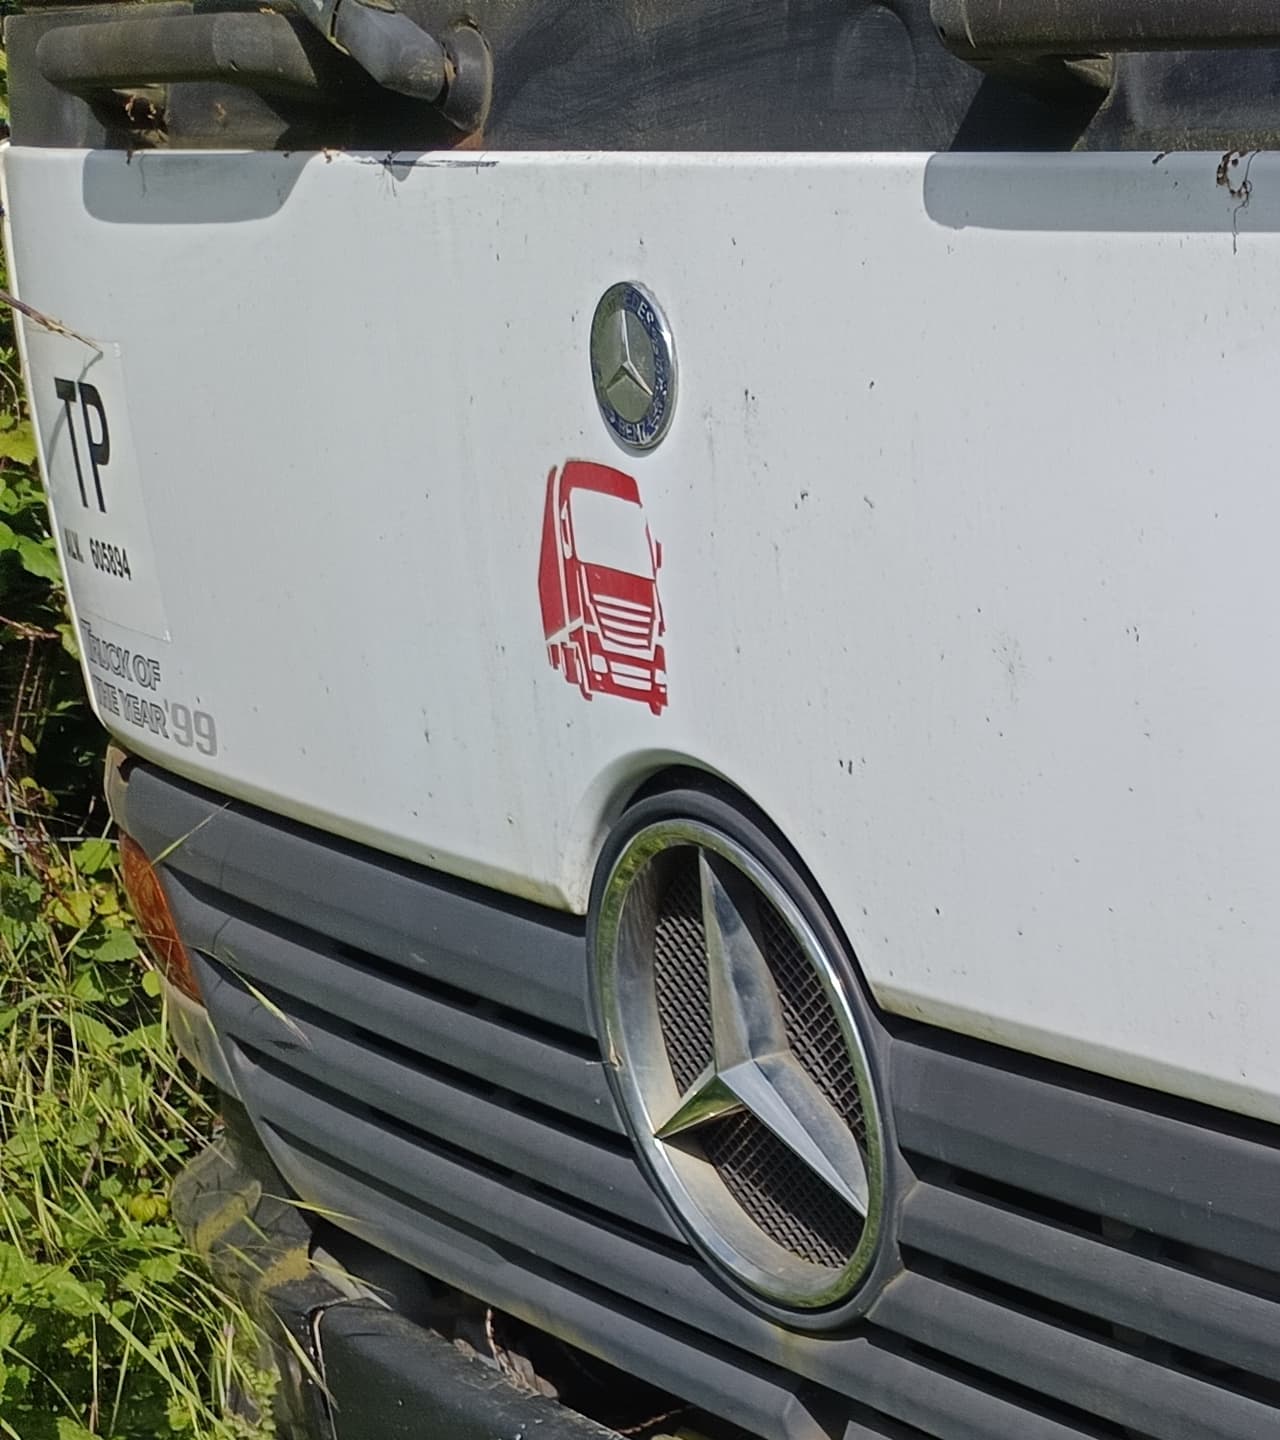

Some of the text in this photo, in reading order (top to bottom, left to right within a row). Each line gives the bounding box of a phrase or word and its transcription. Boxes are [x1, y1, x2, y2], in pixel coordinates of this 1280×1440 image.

[54, 377, 111, 513] TP
[89, 537, 132, 581] 605894
[132, 654, 161, 691] OF
[92, 674, 121, 716] THE
[118, 689, 169, 739] YEAR
